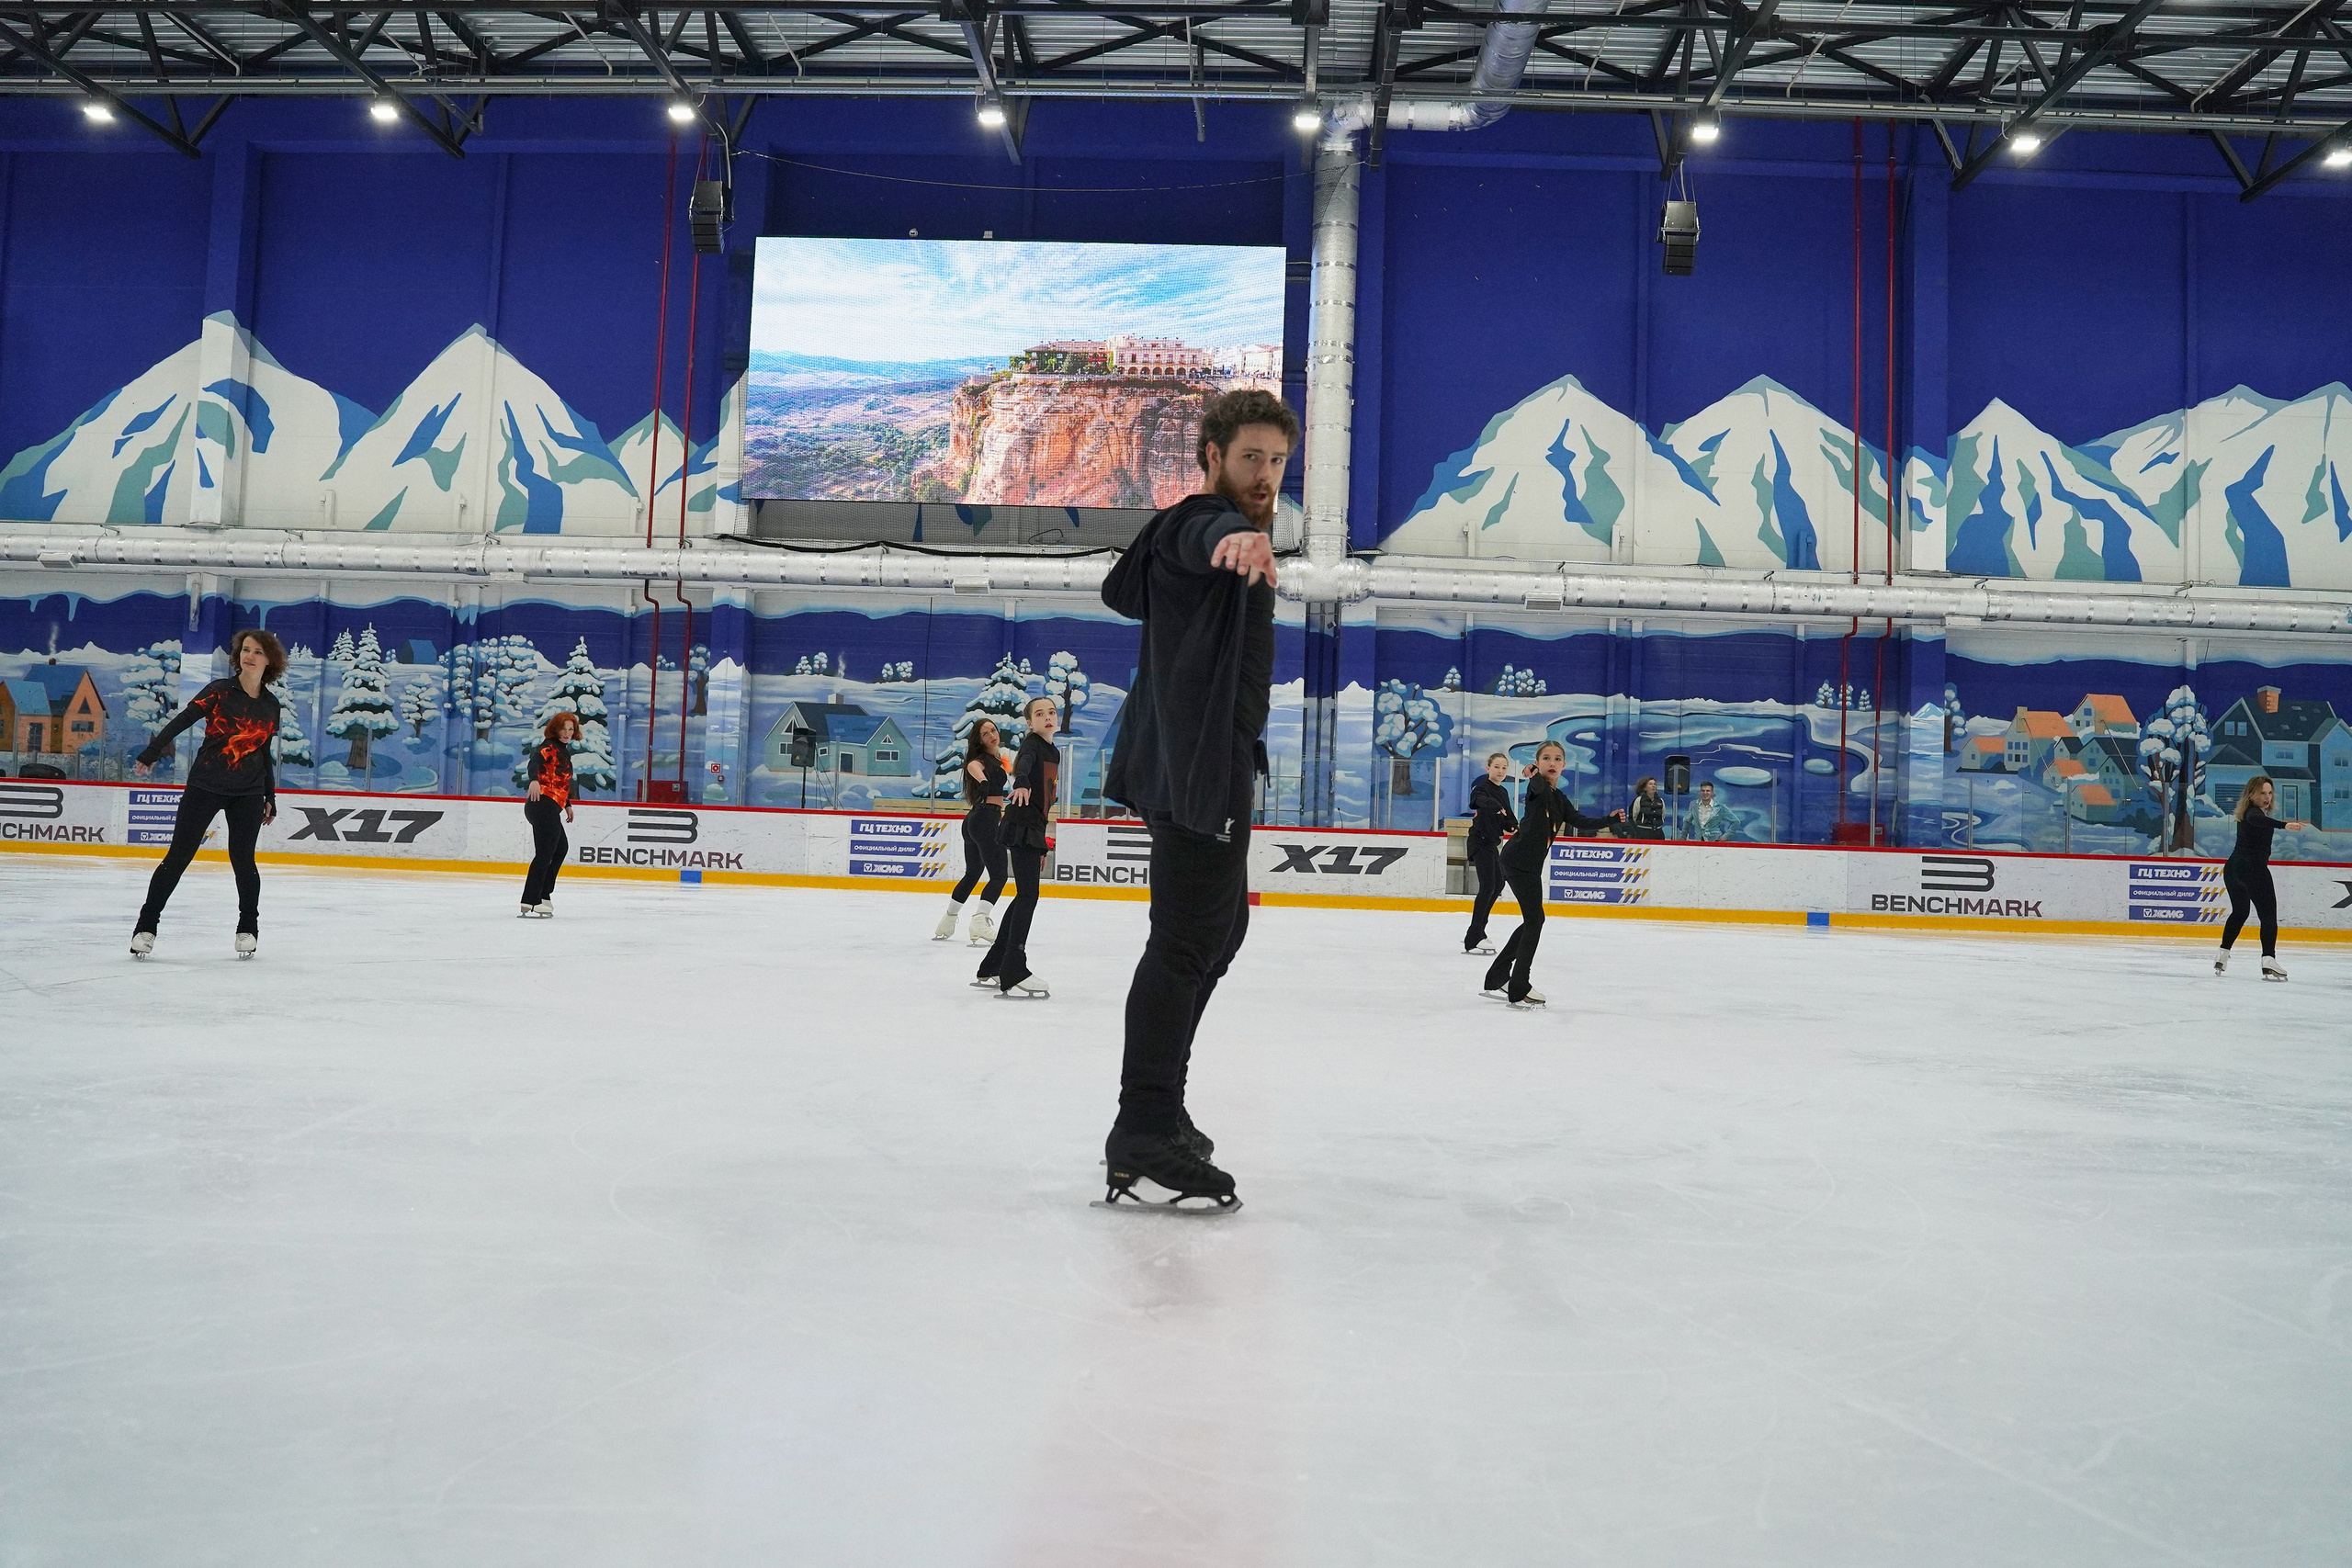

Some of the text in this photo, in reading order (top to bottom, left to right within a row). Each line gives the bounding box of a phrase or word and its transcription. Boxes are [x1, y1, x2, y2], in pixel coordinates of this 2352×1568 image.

[137, 794, 151, 804] ГЦ
[0, 822, 105, 842] CHMARK
[287, 807, 445, 843] X17
[859, 823, 913, 834] ГЦ ТЕХНО
[579, 846, 744, 870] BENCHMARK
[1269, 843, 1409, 875] X17
[1559, 849, 1614, 859] ГЦ ТЕХНО
[1057, 864, 1148, 885] BENCH
[2137, 868, 2191, 878] ГЦ ТЕХНО
[1871, 894, 2042, 918] BENCHMARK
